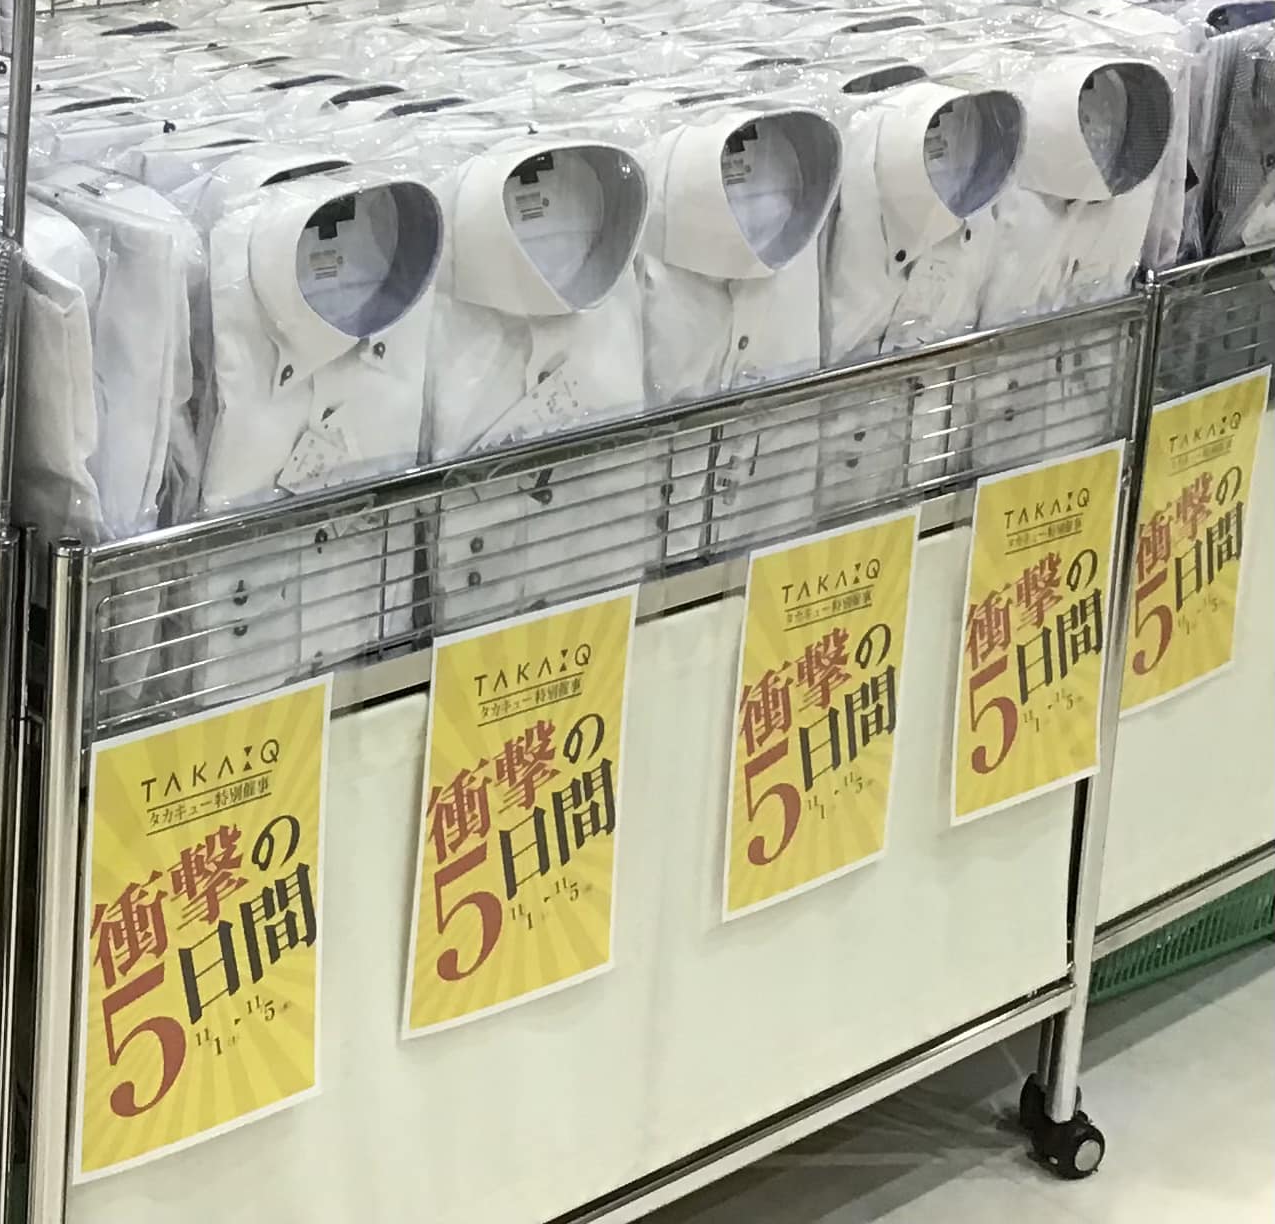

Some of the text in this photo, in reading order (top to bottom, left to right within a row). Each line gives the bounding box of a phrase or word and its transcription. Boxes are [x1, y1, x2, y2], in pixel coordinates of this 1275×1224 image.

[965, 549, 1098, 670] 衝撃の
[1132, 501, 1244, 675] 5日間
[1135, 465, 1242, 583] 衝撃の
[739, 623, 892, 757] 衝撃の
[744, 664, 896, 867] 5日間
[970, 588, 1103, 774] 5日間
[427, 713, 604, 865] 衝撃の
[434, 757, 616, 982] 5日間
[90, 814, 301, 990] 衝撃の
[102, 862, 317, 1117] 5日間
